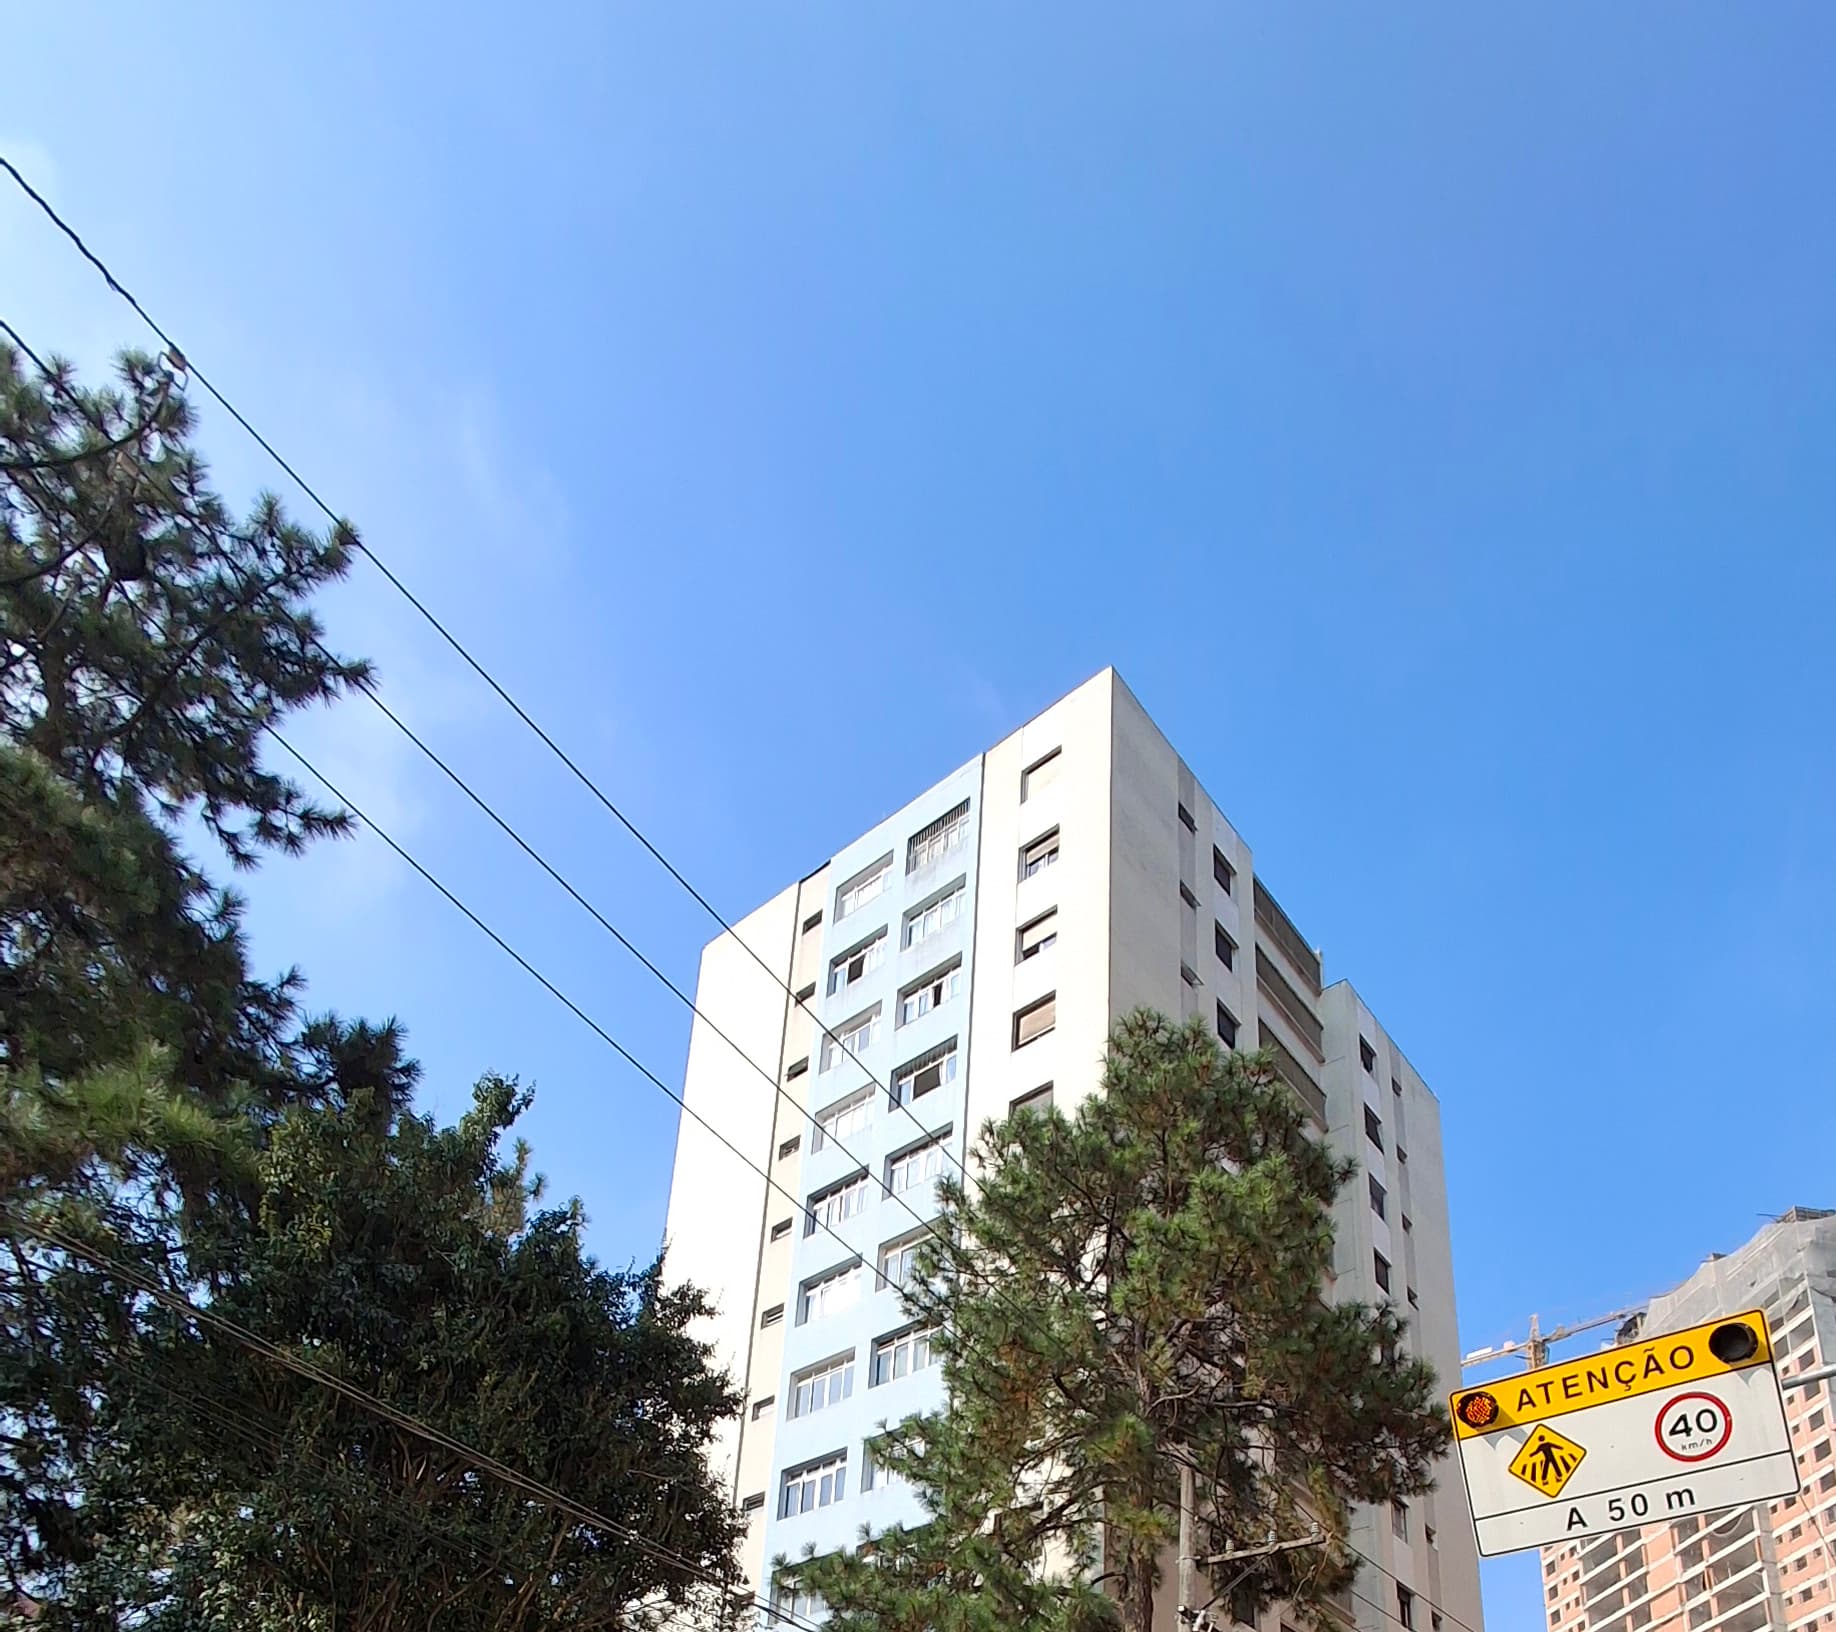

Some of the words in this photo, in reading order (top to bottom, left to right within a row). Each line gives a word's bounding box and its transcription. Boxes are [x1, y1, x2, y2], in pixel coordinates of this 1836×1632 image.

[1516, 1345, 1695, 1412] ATENÇÃO
[1668, 1408, 1718, 1437] 40
[1681, 1438, 1713, 1451] km/h
[1566, 1507, 1588, 1531] A
[1608, 1493, 1648, 1522] 50
[1665, 1488, 1696, 1510] m
